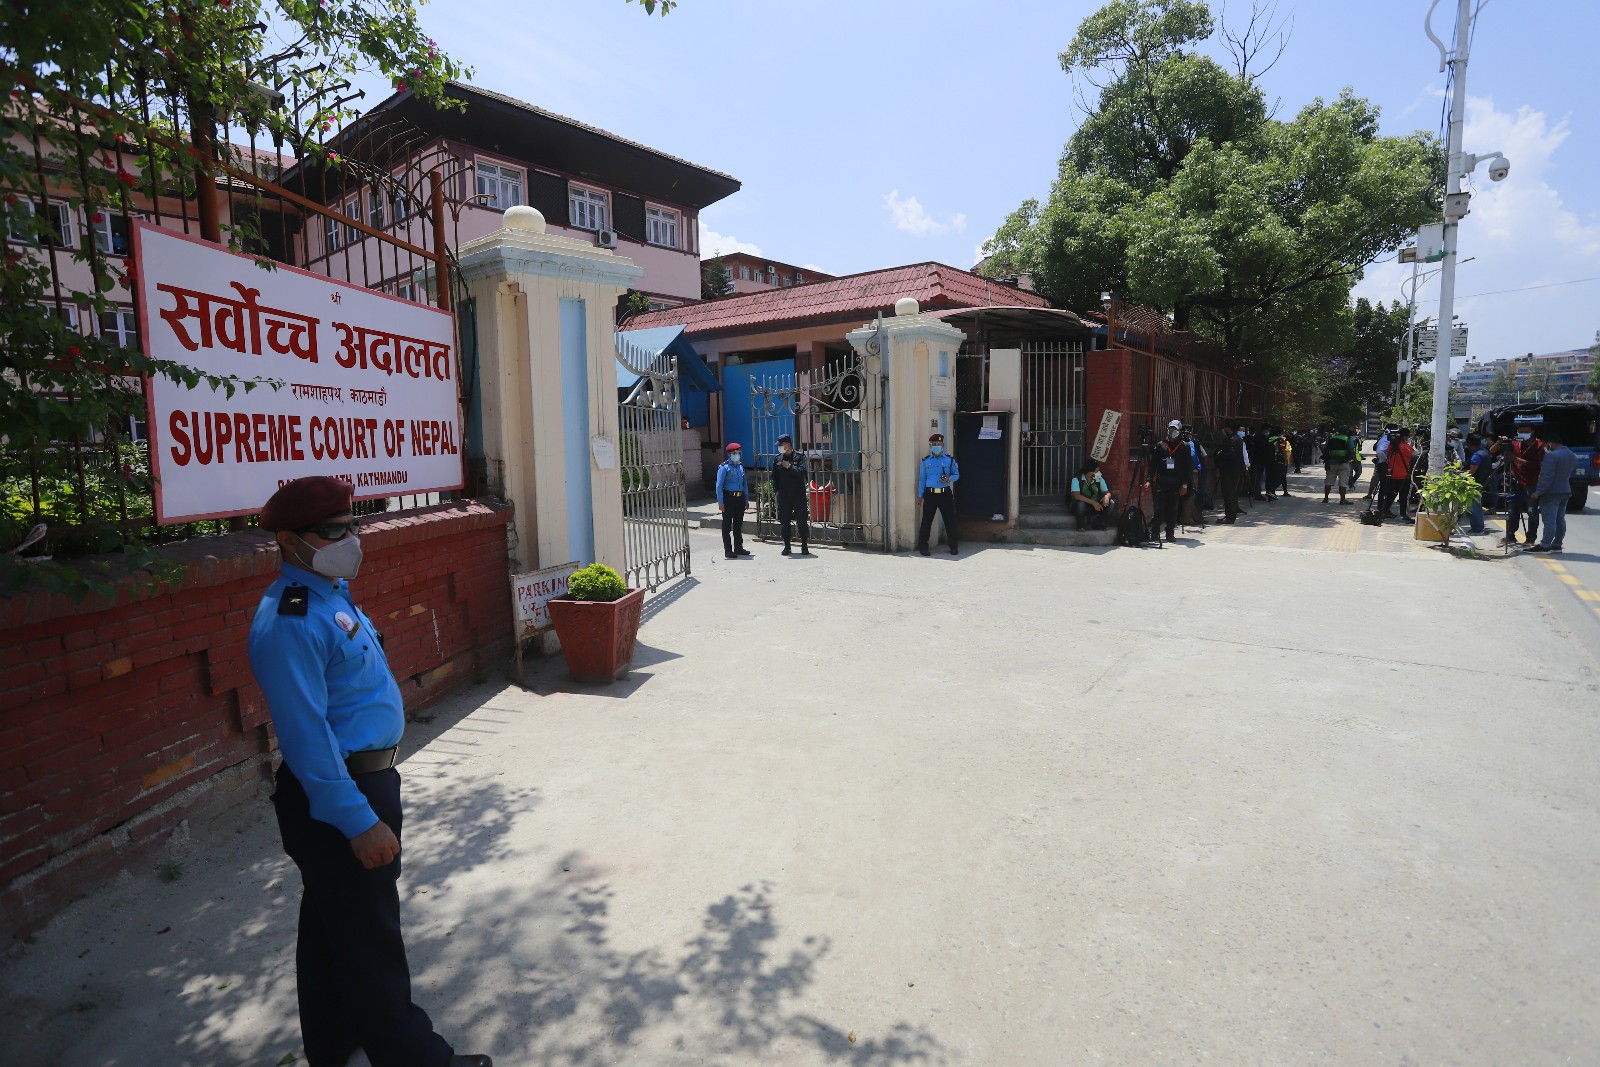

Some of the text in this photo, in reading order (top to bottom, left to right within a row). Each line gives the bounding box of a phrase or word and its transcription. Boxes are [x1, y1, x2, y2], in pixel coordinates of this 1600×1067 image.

[331, 291, 342, 305] श्री
[157, 281, 451, 382] सर्वोच्च अदालत
[169, 409, 458, 466] SUPREME COURT OF NEPAL
[357, 470, 408, 487] KATHMANDU
[517, 575, 569, 602] PARKIN
